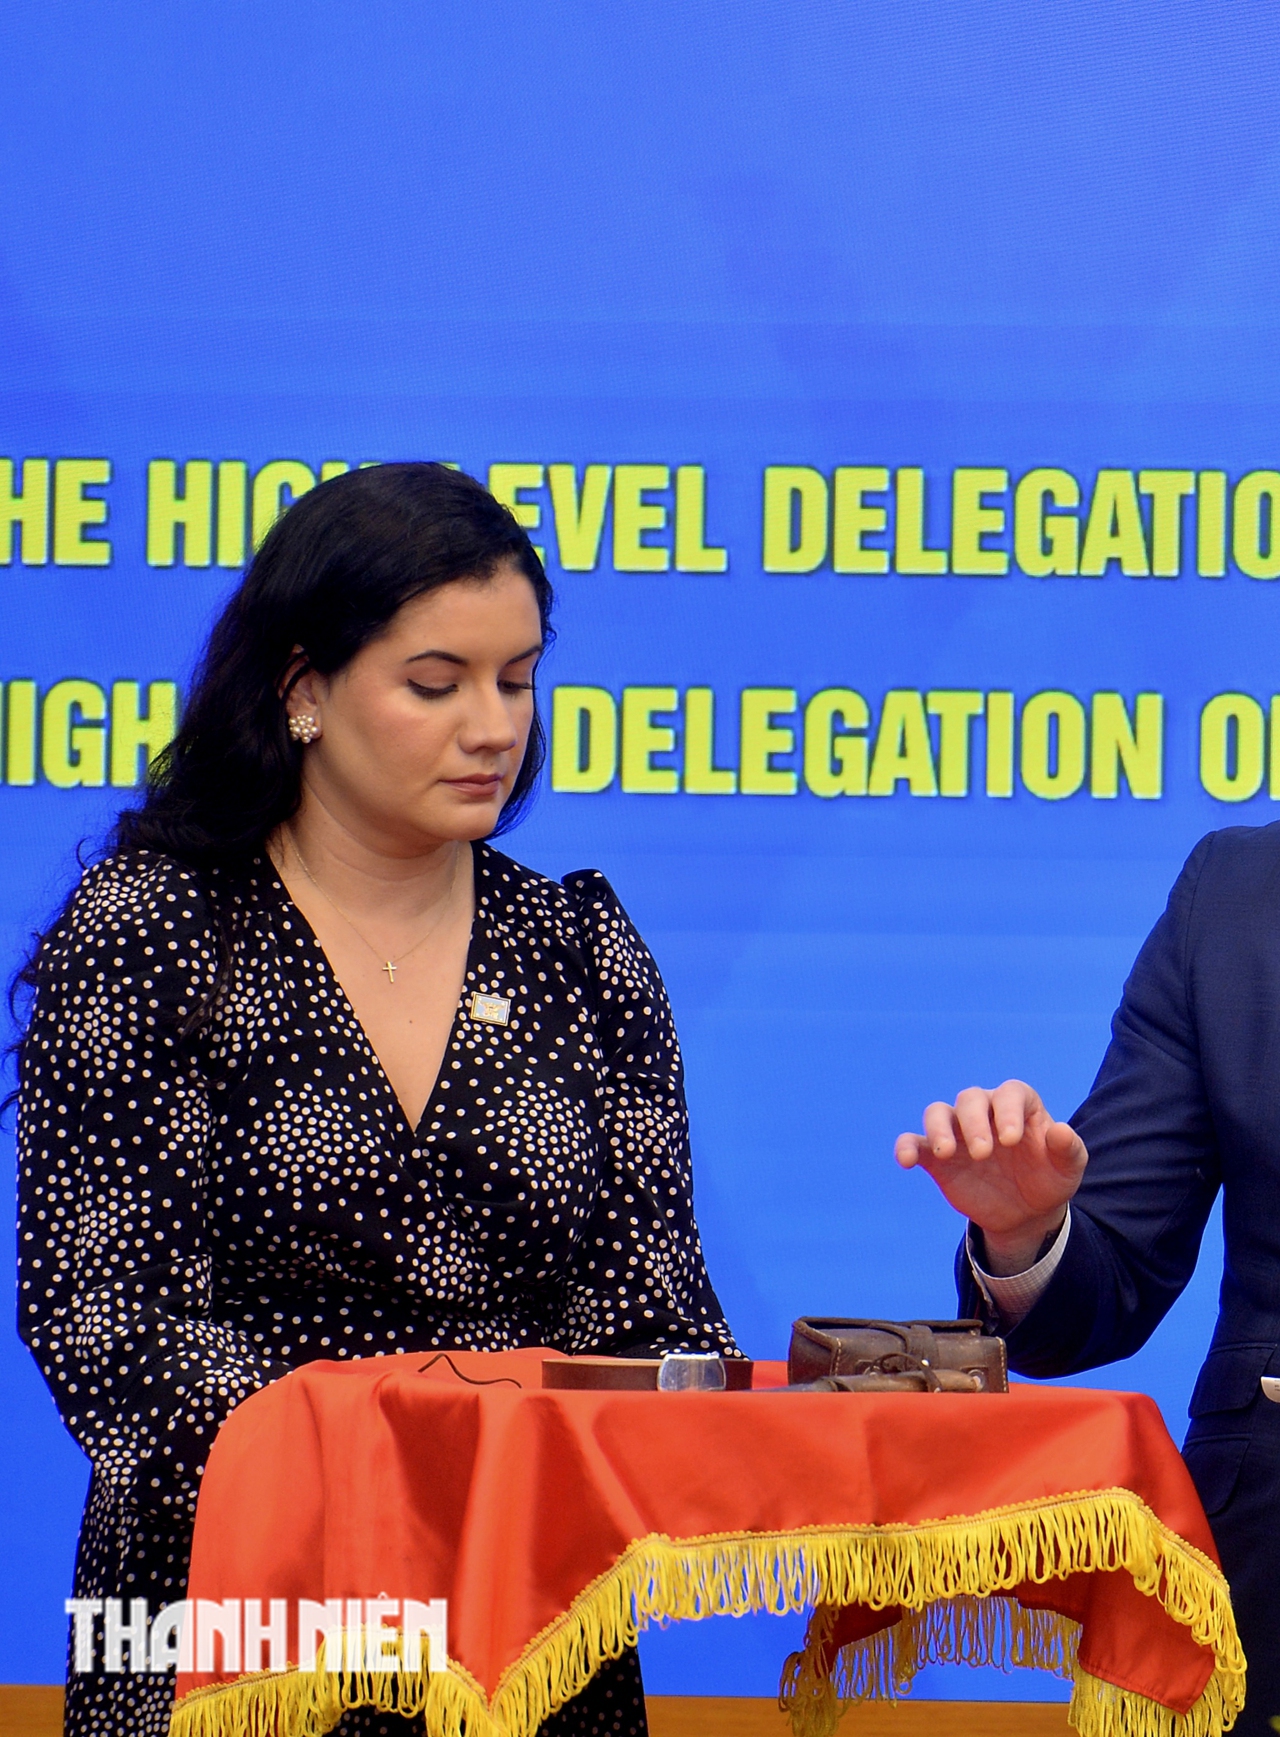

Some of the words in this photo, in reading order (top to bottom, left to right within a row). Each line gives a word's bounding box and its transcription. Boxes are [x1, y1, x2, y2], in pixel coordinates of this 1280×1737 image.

[0, 459, 111, 564] HE
[450, 464, 728, 571] EVEL
[0, 680, 176, 787] IGH
[552, 687, 1162, 800] DELEGATION
